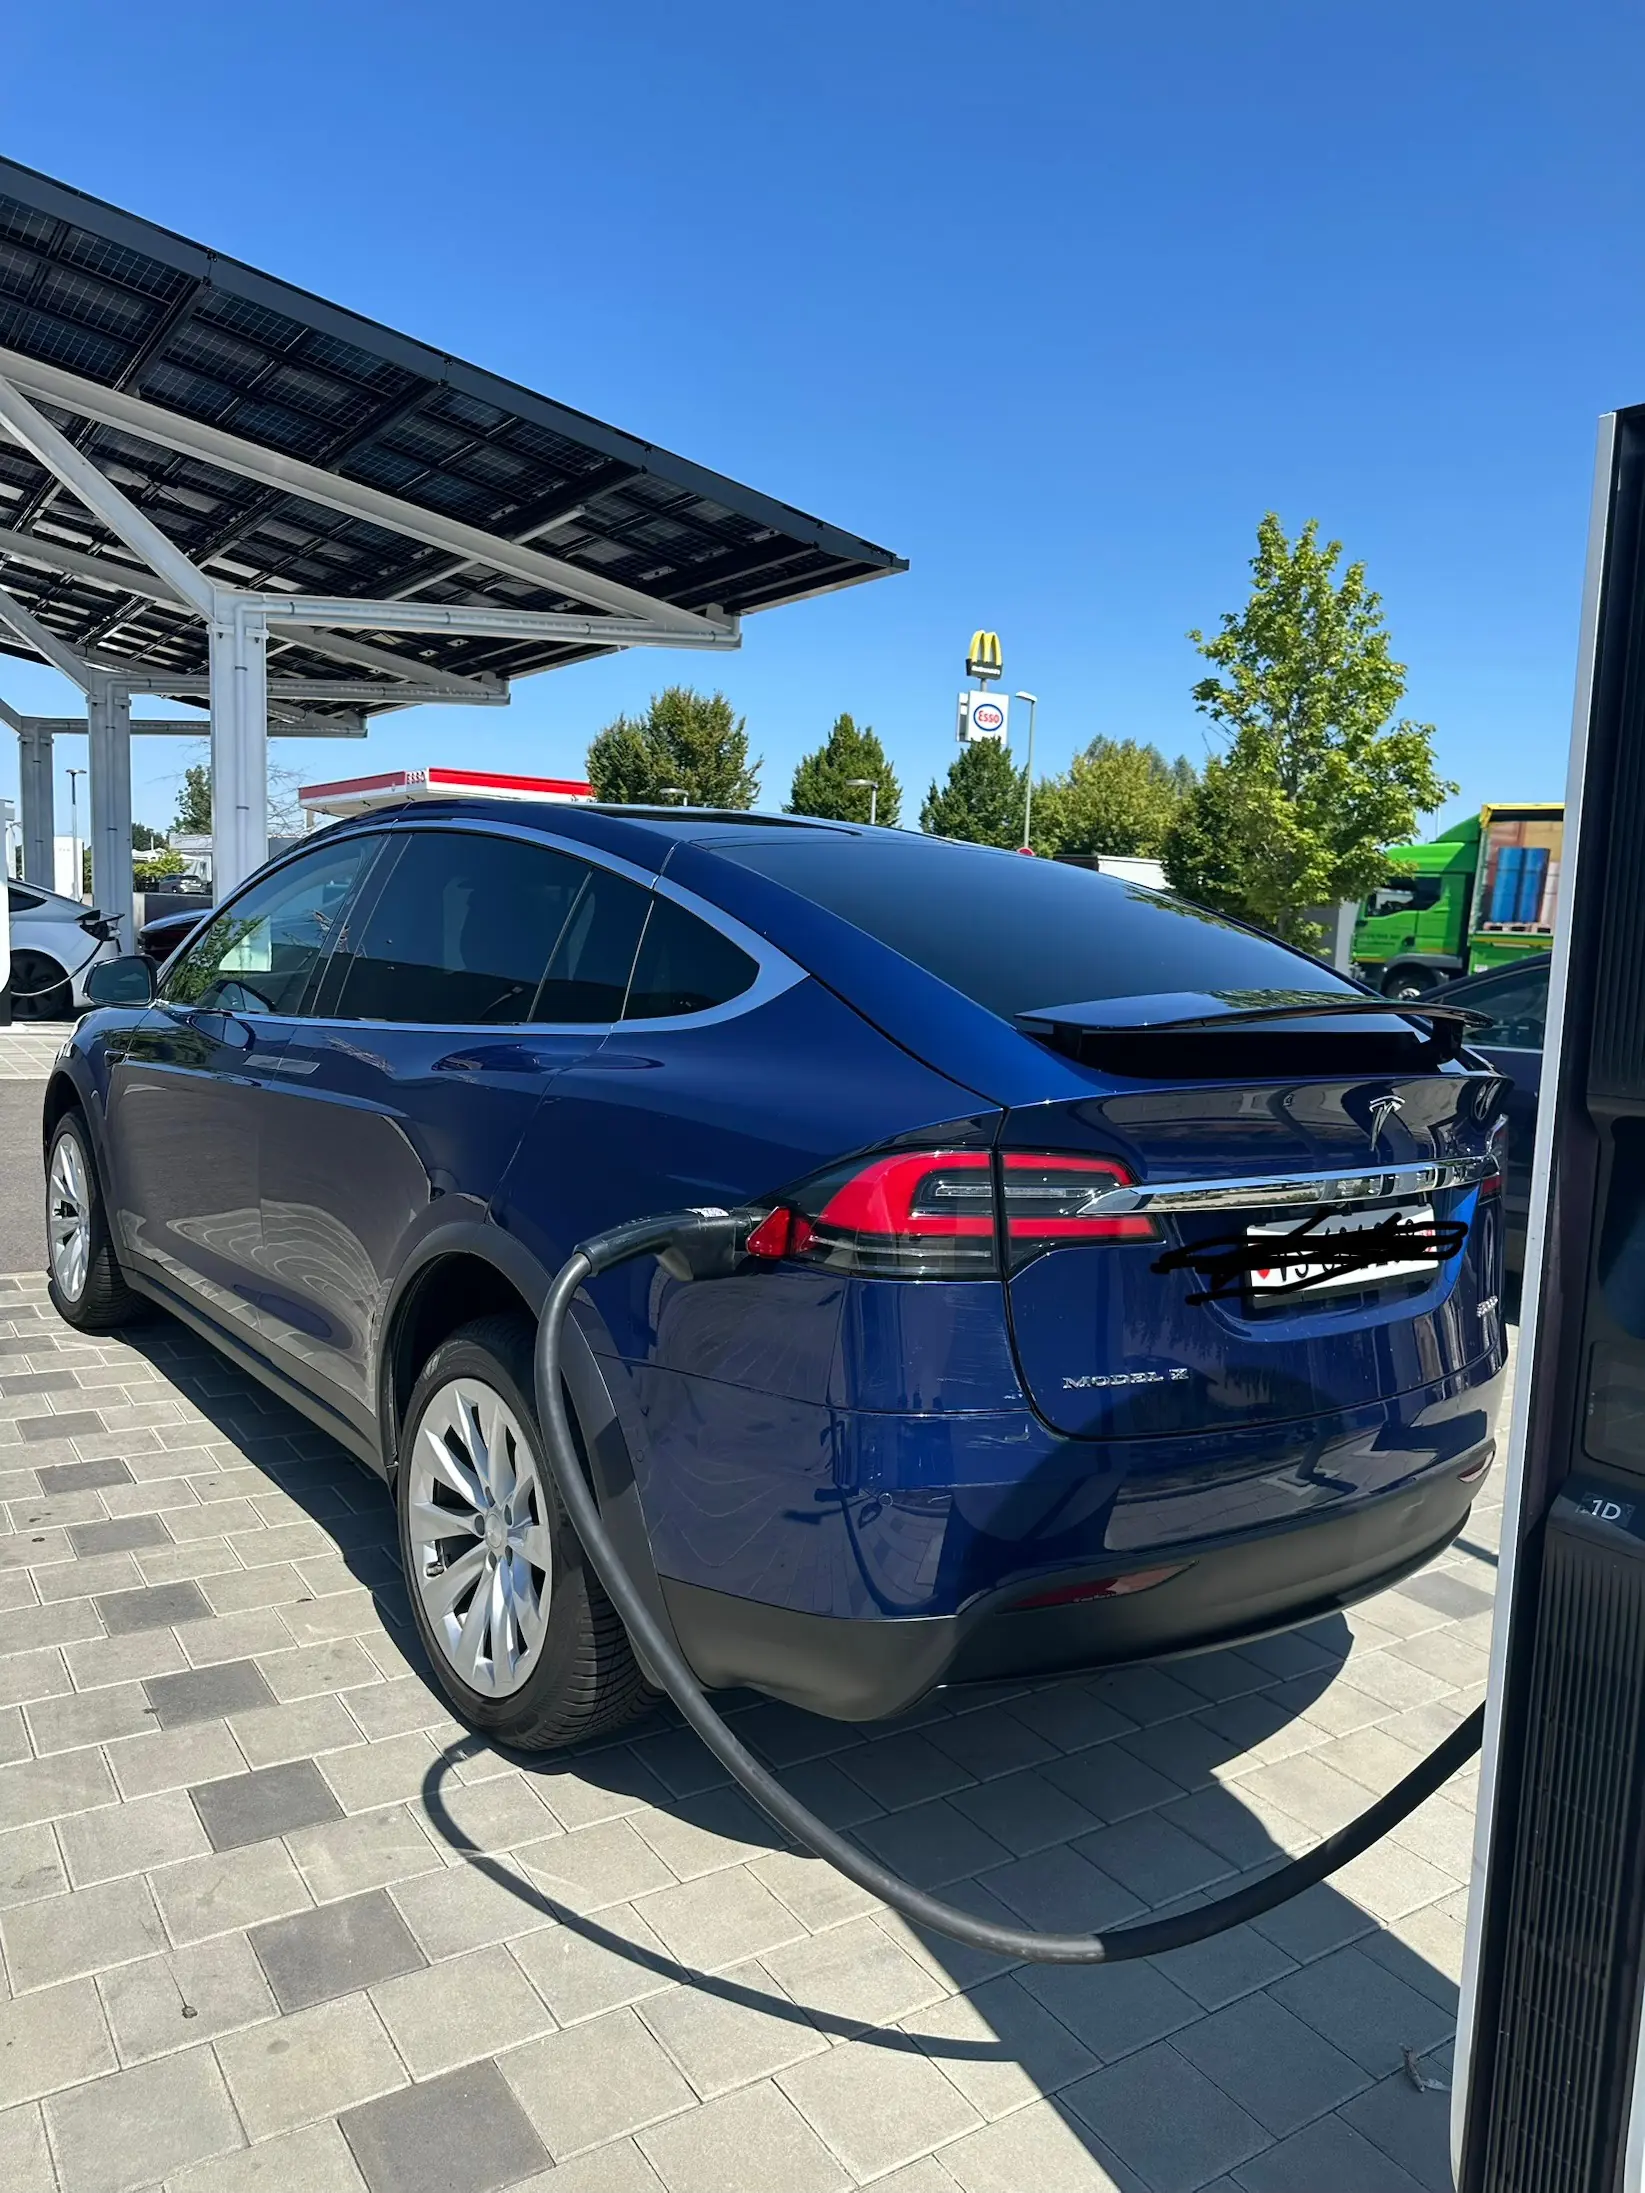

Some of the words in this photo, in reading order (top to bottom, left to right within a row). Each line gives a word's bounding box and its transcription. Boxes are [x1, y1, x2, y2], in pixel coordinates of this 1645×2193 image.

[978, 710, 1000, 724] Esso
[1062, 1371, 1164, 1389] MODEL
[1168, 1367, 1189, 1381] X
[1591, 1499, 1622, 1520] 1D
